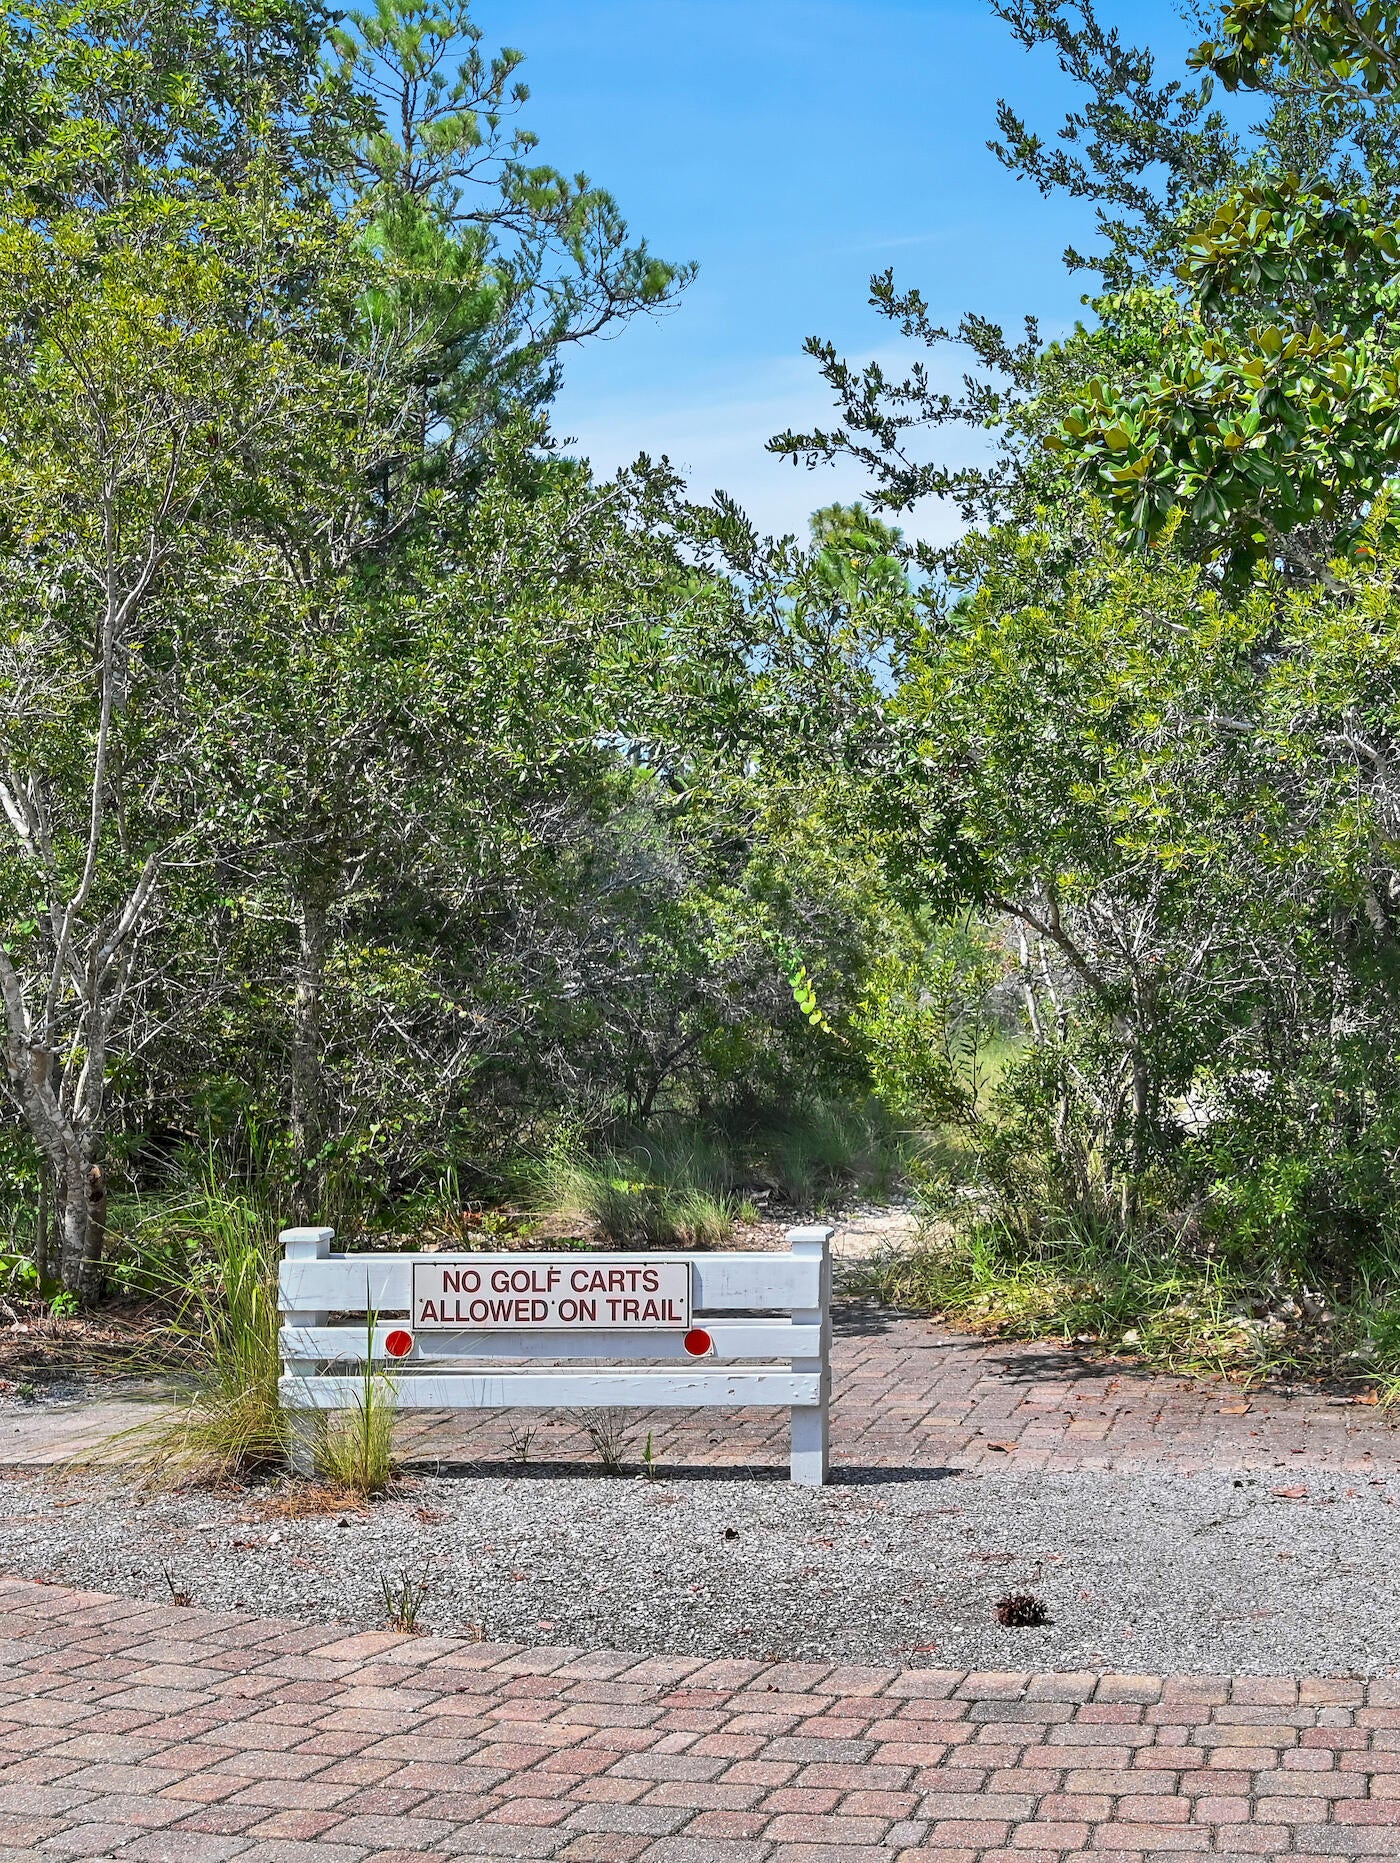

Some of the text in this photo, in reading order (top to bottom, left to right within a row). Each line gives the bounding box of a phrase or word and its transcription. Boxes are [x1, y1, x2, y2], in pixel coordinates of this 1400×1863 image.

[443, 1269, 660, 1293] NO GOLF CARTS
[420, 1299, 683, 1322] ALLOWED ON TRAIL
